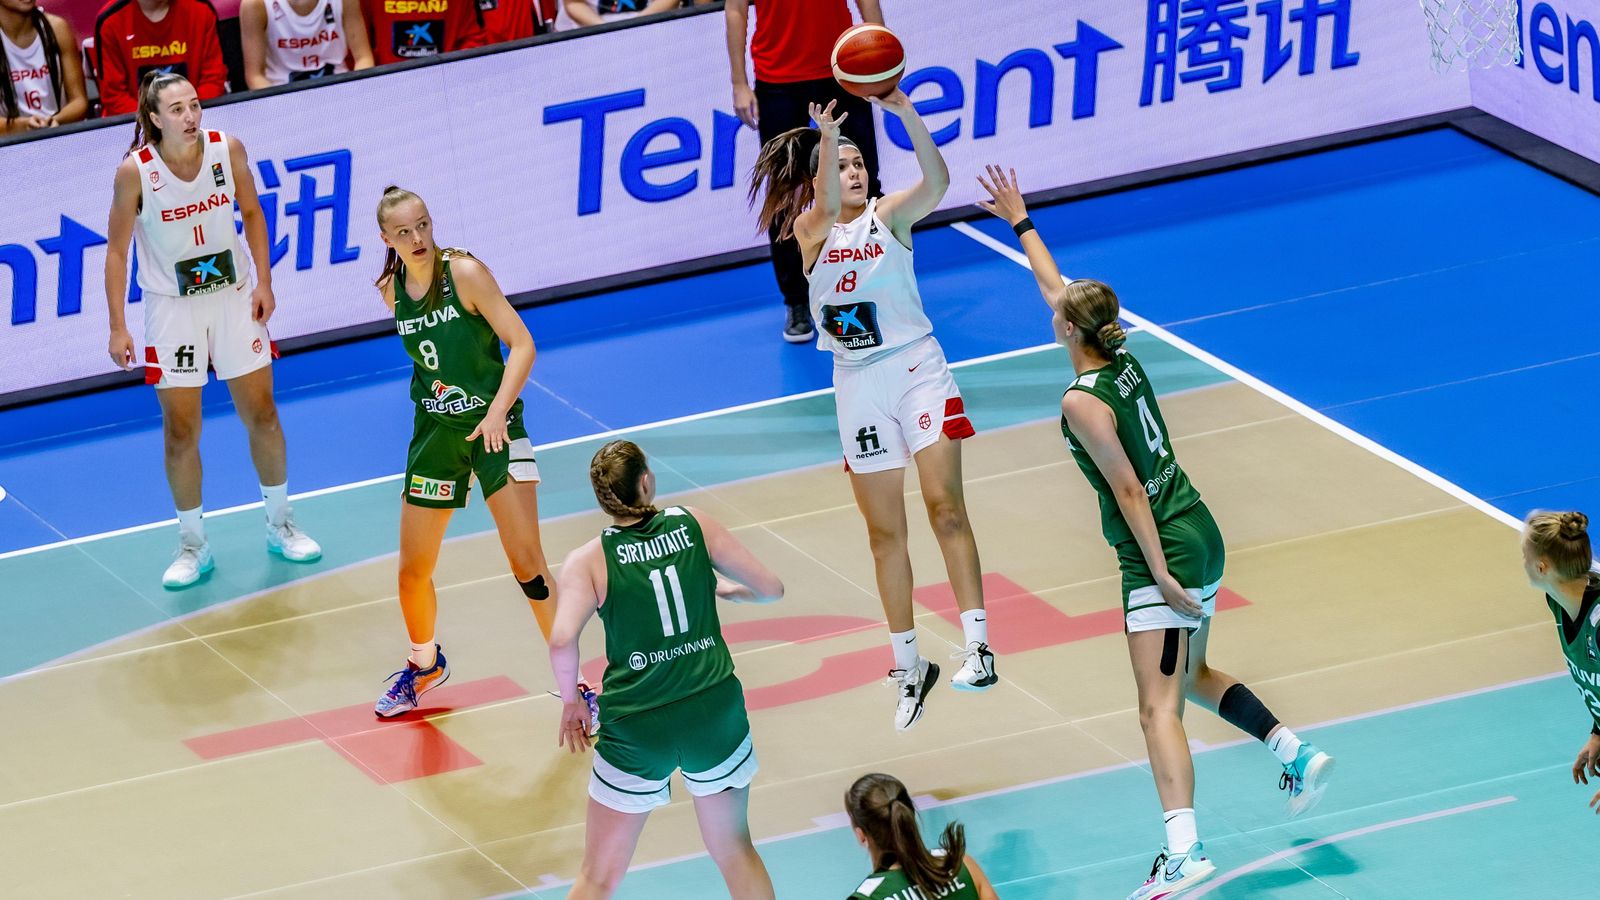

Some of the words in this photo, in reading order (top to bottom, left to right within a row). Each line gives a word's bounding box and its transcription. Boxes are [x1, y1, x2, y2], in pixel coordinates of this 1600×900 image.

[277, 30, 339, 49] ESPAÑA
[23, 90, 42, 111] 16
[542, 18, 1123, 217] Teent
[161, 193, 230, 222] ESPAÑA
[193, 223, 205, 246] 11
[836, 270, 858, 294] 18
[839, 335, 876, 348] ixaBank
[174, 345, 195, 368] fi
[418, 339, 439, 371] 8
[170, 366, 199, 374] network
[1136, 395, 1169, 457] 4
[855, 425, 880, 452] fi
[856, 447, 888, 460] network
[616, 524, 694, 565] SIRTAUTAITĖ
[648, 564, 689, 637] 11
